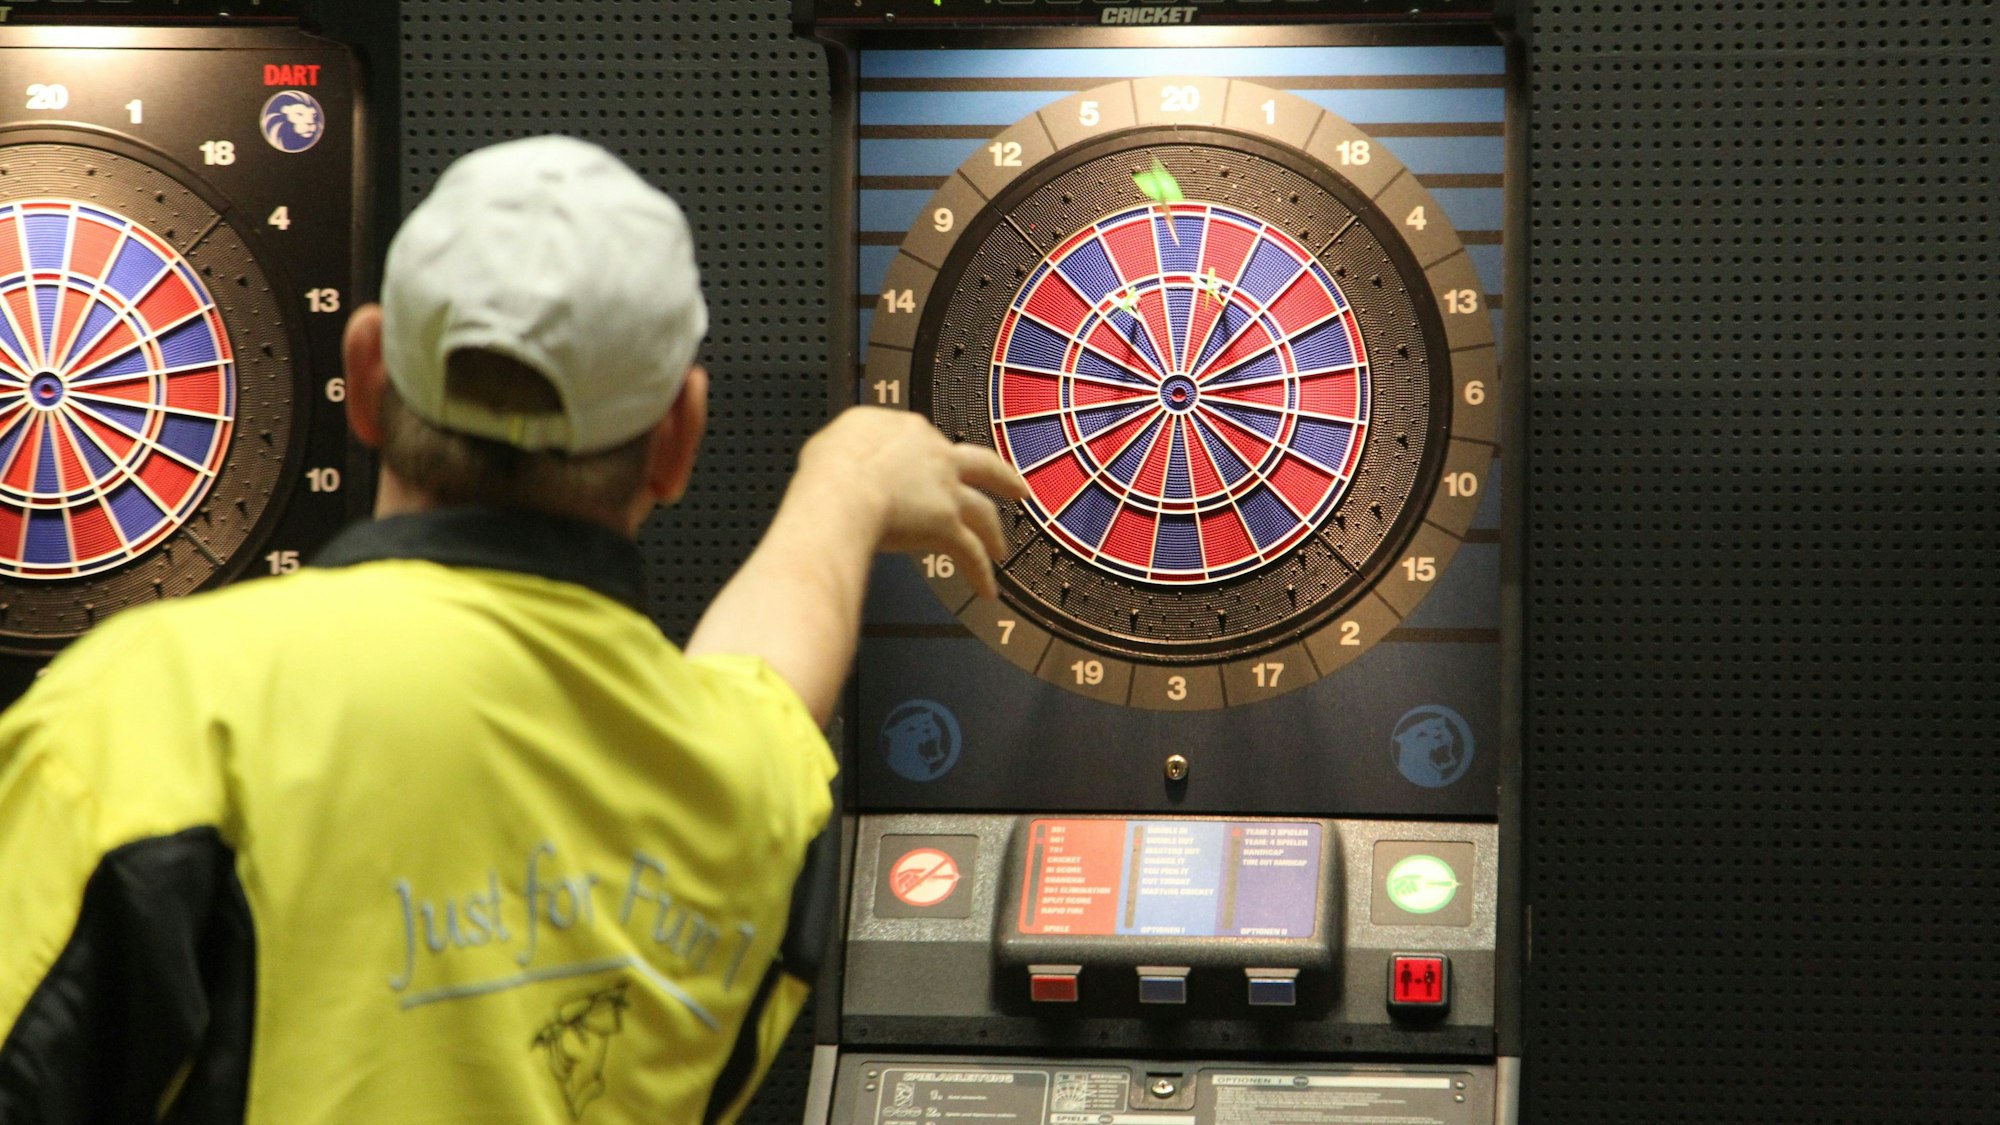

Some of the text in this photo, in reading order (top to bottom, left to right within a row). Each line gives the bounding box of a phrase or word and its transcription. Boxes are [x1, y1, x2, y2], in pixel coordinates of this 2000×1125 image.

[1101, 6, 1198, 24] CRICKET
[264, 64, 320, 86] DART
[26, 84, 69, 109] 20
[1162, 86, 1200, 111] 20
[126, 99, 142, 123] 1
[1080, 101, 1099, 126] 5
[1262, 100, 1275, 124] 1
[200, 141, 235, 165] 18
[990, 142, 1022, 166] 12
[1337, 141, 1369, 165] 18
[269, 207, 290, 231] 4
[935, 208, 953, 232] 9
[1407, 206, 1426, 230] 4
[306, 289, 339, 313] 13
[884, 290, 915, 313] 14
[1444, 290, 1477, 313] 13
[326, 379, 344, 402] 6
[874, 381, 900, 404] 11
[1465, 381, 1484, 405] 6
[306, 469, 339, 492] 10
[1444, 473, 1477, 496] 10
[266, 551, 300, 574] 15
[923, 554, 954, 578] 16
[1403, 557, 1435, 581] 15
[998, 621, 1015, 644] 7
[1341, 621, 1360, 645] 2
[1072, 661, 1103, 684] 19
[1253, 663, 1284, 687] 17
[1168, 677, 1186, 700] 3
[1244, 838, 1269, 846] TEAM:
[1276, 839, 1308, 847] SPIELER
[1246, 828, 1269, 836] TEAM:
[1277, 829, 1309, 837] SPIELER
[1047, 856, 1081, 864] CRICKET
[1056, 866, 1082, 874] SCORE
[1274, 859, 1308, 867] HANDICAP
[1060, 887, 1111, 895] ELIMINATION
[1066, 897, 1092, 905] SCORE
[389, 869, 511, 991] Just
[515, 839, 599, 967] for
[620, 849, 720, 976] Fun
[1041, 907, 1066, 915] RAPID
[1043, 925, 1070, 933] SPIELE
[1140, 926, 1182, 935] OPTIONEN
[1240, 927, 1281, 936] OPTIONEN
[1216, 1076, 1272, 1085] OPTIONEN
